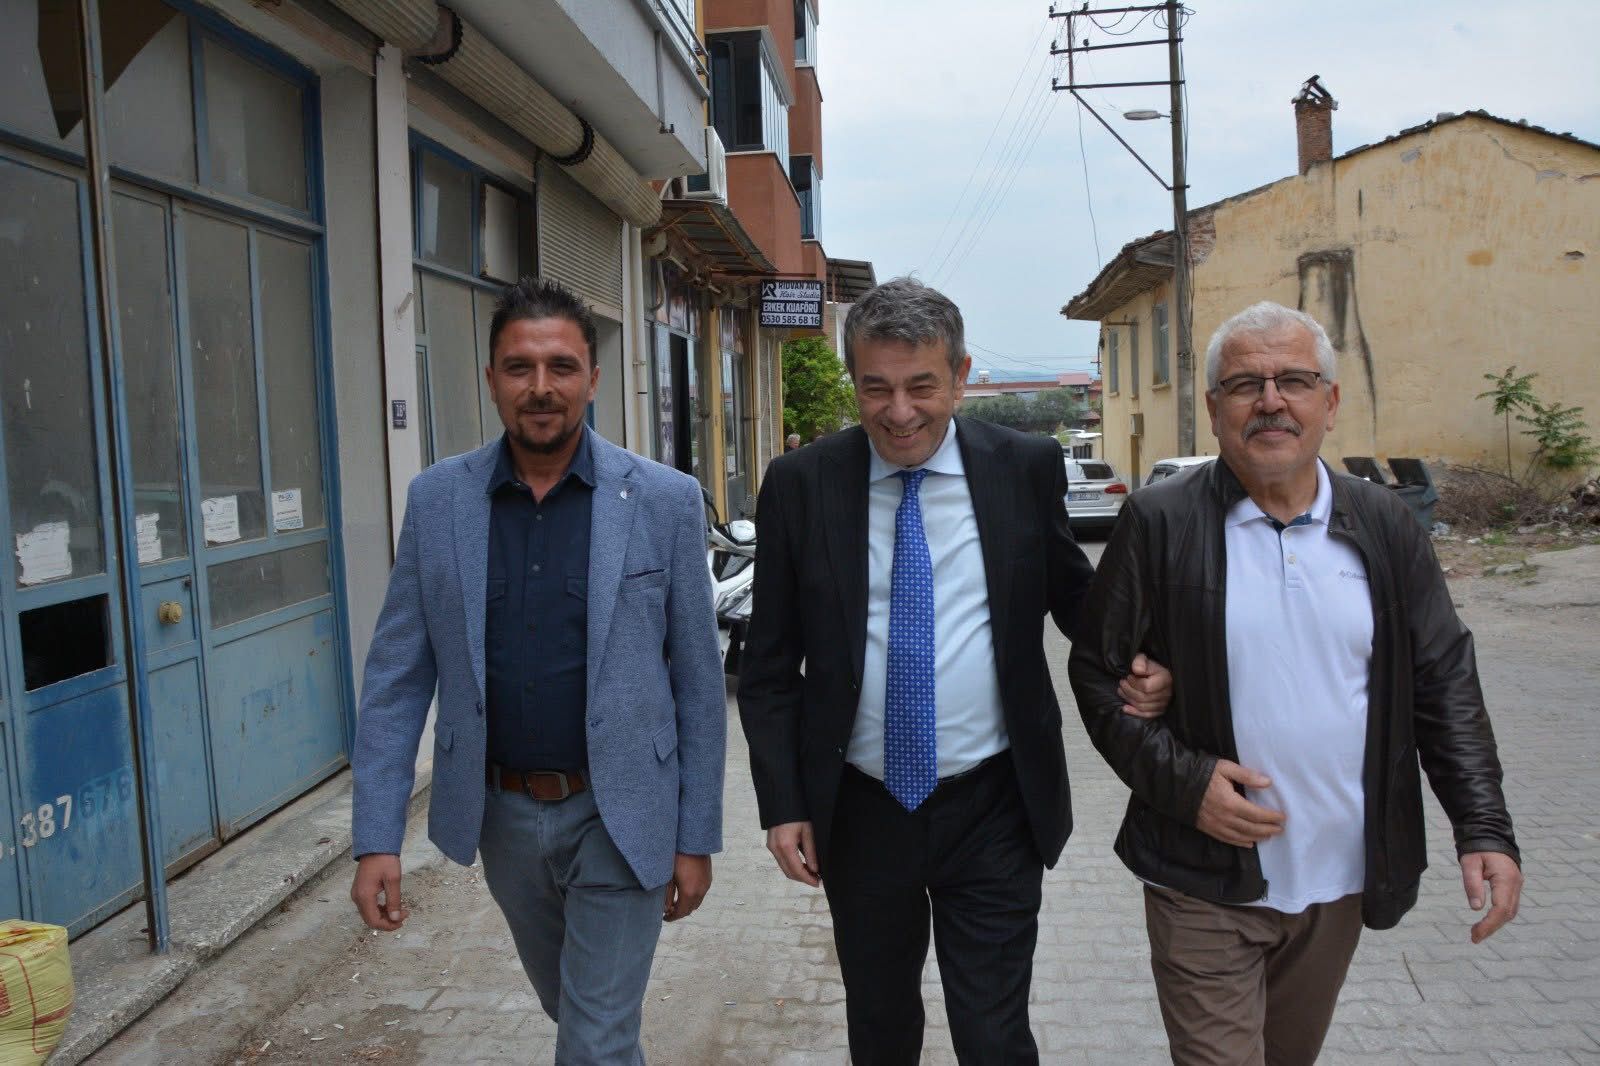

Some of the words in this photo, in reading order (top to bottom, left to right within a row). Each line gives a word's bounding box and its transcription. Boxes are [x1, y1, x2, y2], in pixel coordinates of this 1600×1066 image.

[763, 302, 785, 312] ERKEK
[786, 301, 818, 313] KUAFÖRÜ
[762, 315, 781, 323] 0530
[782, 315, 797, 324] 585
